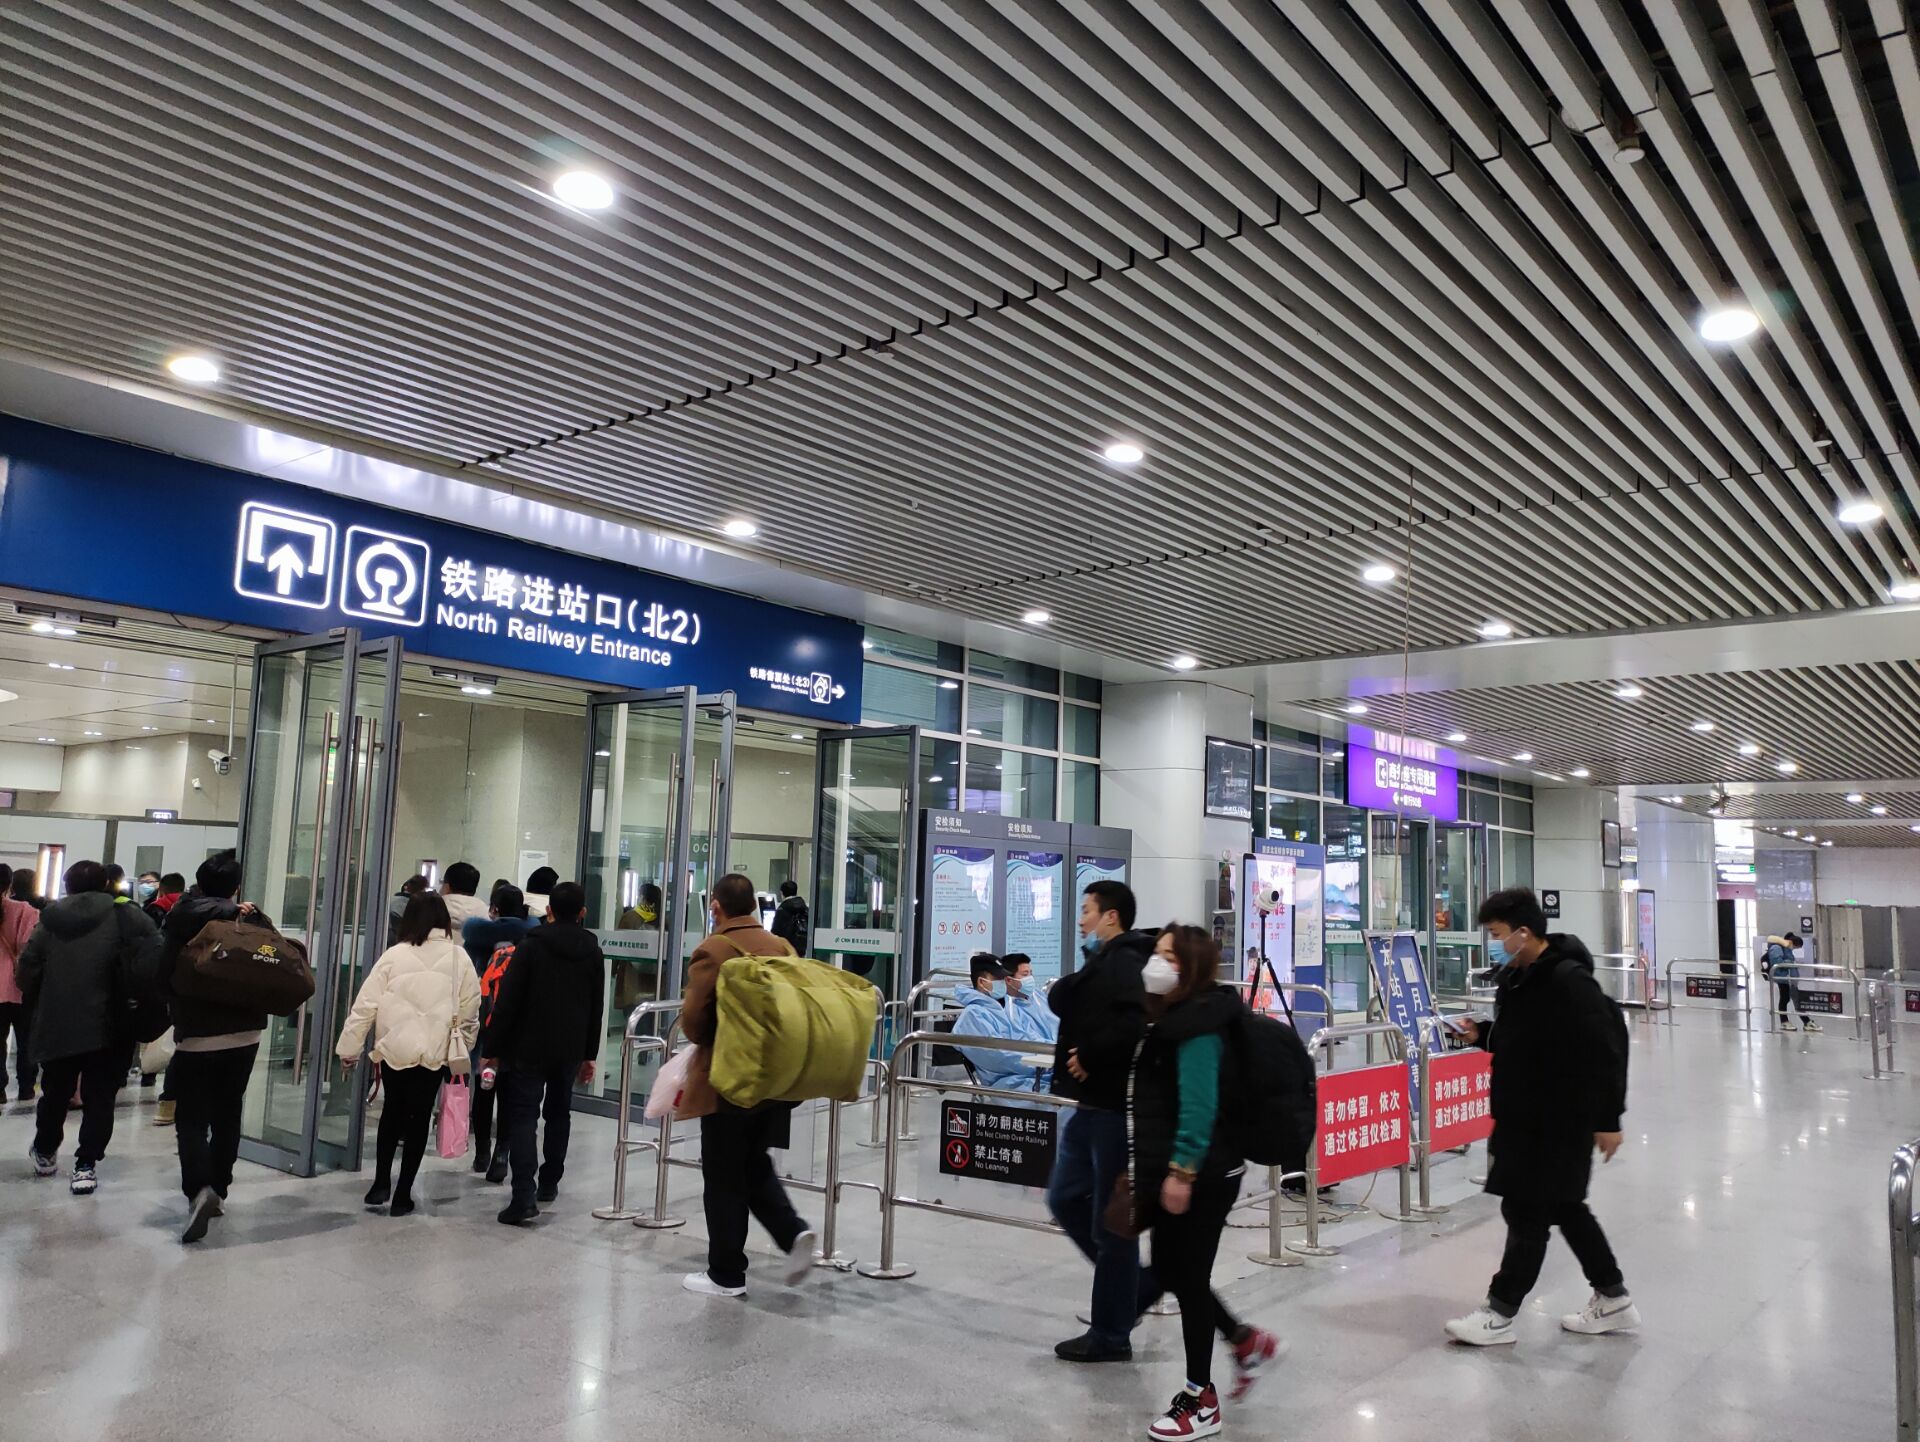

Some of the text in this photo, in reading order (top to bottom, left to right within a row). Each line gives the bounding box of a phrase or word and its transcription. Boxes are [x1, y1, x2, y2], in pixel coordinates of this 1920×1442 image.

[440, 556, 701, 645] 铁路进站口(北2)
[436, 603, 672, 666] North Railway Entrance
[934, 816, 962, 828] 安检须知
[1007, 822, 1033, 834] 安检须知
[252, 953, 280, 964] SPORT
[1324, 1089, 1400, 1125] 请勿停留，依次
[975, 1112, 1049, 1136] 请勿翻越栏杆
[975, 1129, 1048, 1147] Do Not Climb Over Railings
[1324, 1117, 1401, 1157] 通过体温仪检测
[974, 1143, 1023, 1165] 禁止倚靠
[974, 1161, 1009, 1174] No Leaning
